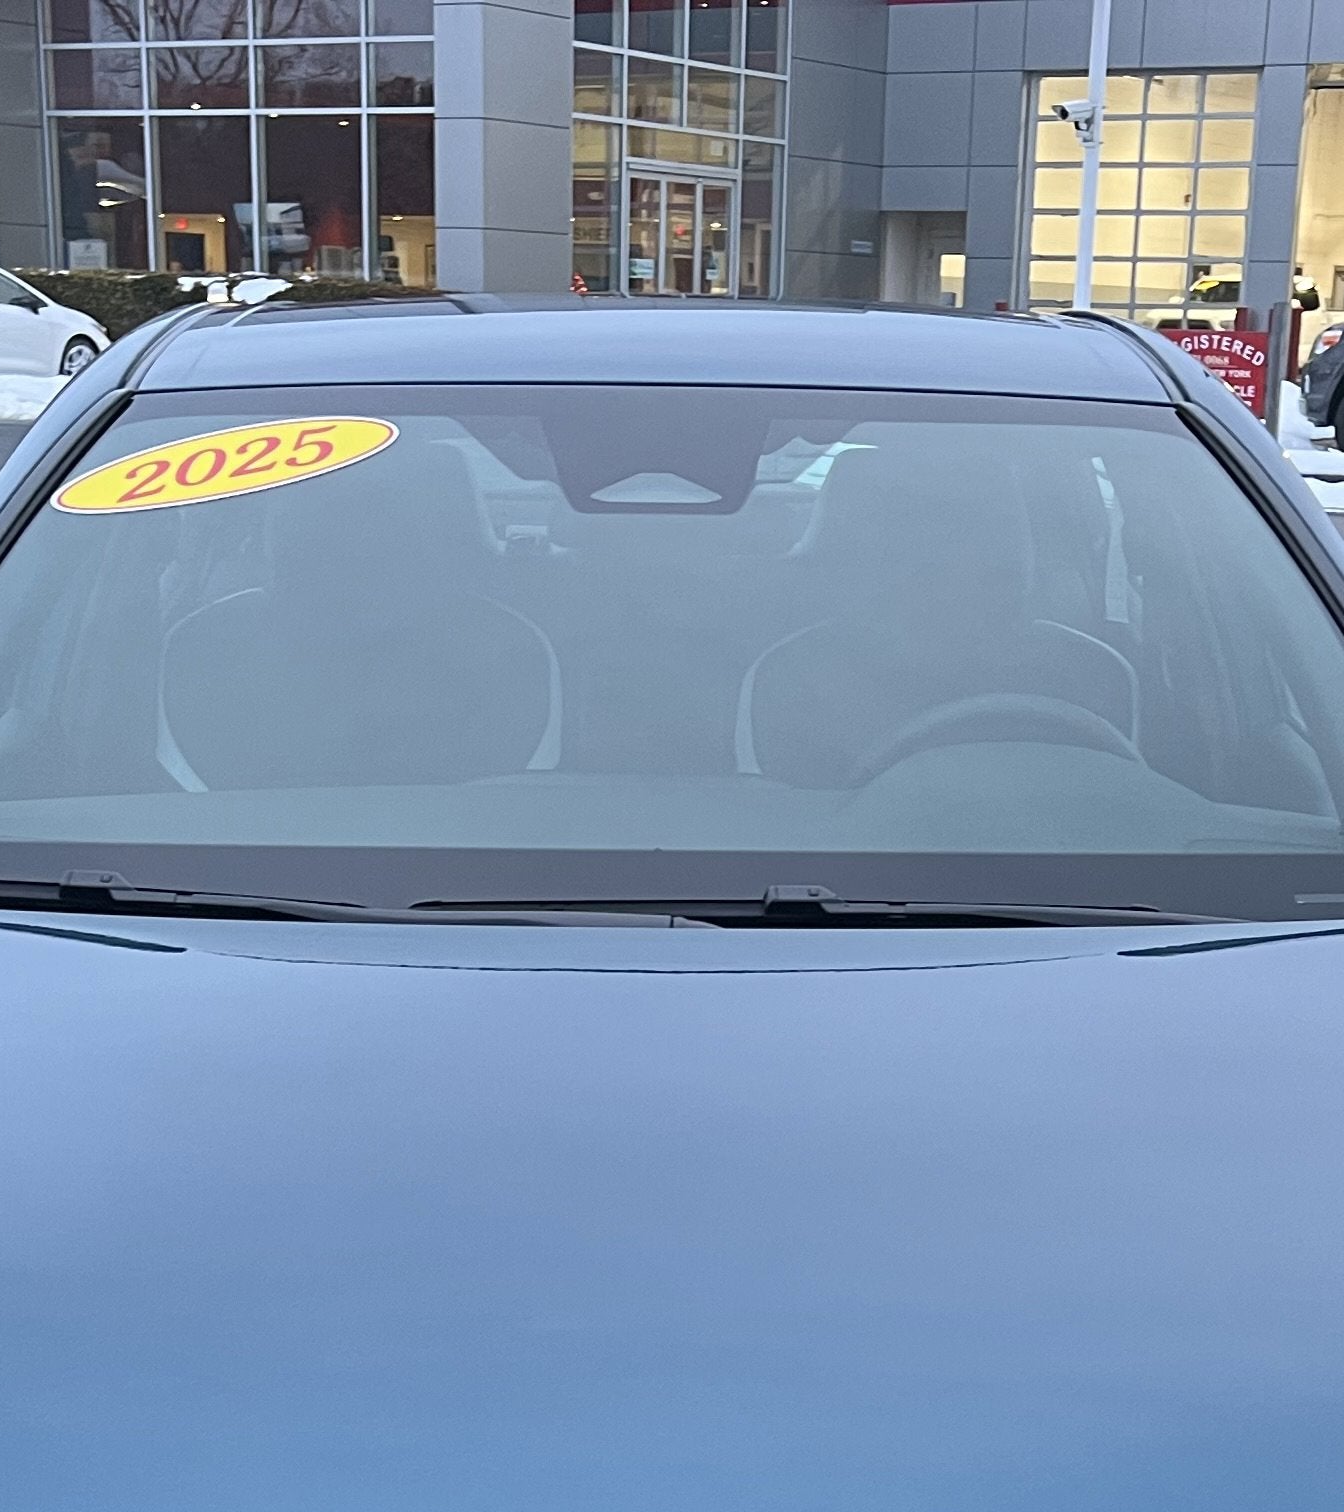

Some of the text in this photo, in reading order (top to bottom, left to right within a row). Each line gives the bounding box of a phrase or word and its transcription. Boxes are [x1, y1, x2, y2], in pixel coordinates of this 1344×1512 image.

[1175, 334, 1265, 366] GISTERED
[1228, 369, 1252, 378] YORK
[1233, 385, 1256, 397] CLE
[117, 425, 337, 503] 2025
